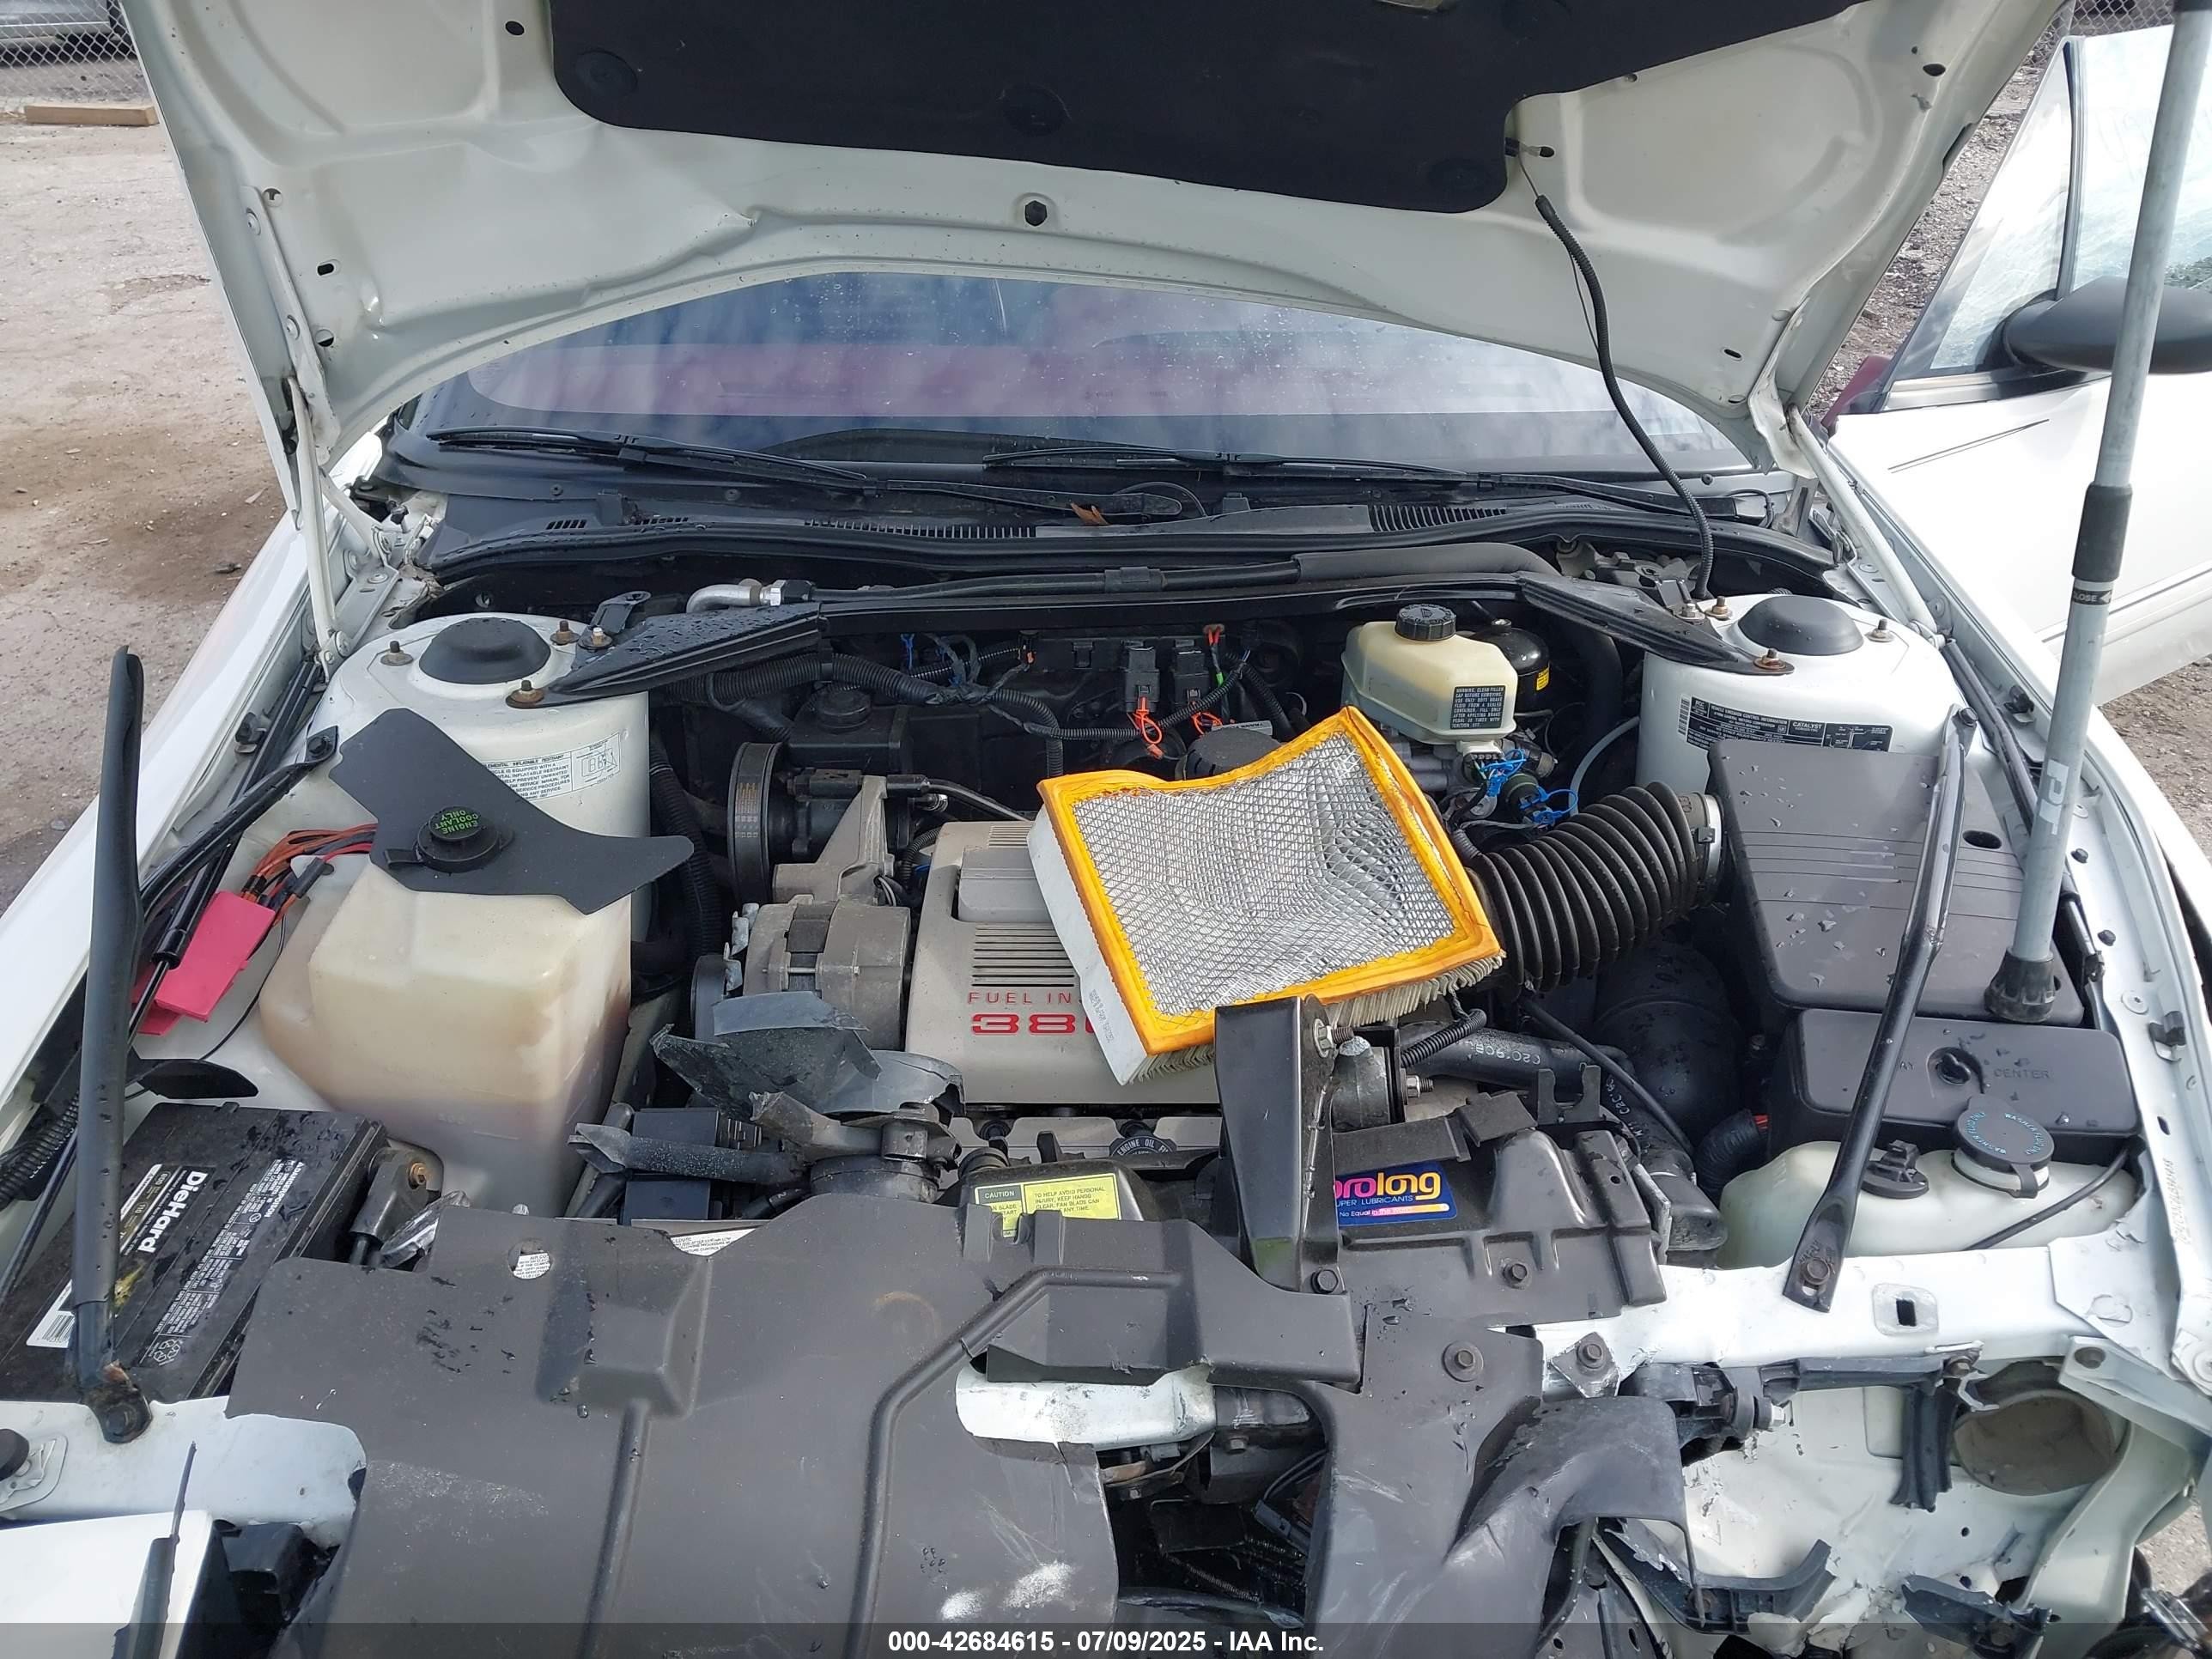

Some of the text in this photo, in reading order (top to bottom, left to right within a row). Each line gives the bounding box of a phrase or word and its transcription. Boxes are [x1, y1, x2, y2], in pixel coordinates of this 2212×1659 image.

[434, 813, 479, 830] COOLANT
[441, 810, 465, 820] ONLY
[441, 820, 478, 834] ENGINE
[968, 993, 1071, 1004] FUEL IN
[972, 1013, 1094, 1034] 38
[1994, 1068, 2050, 1079] CENTER
[1117, 1139, 1140, 1156] ENGINE
[1145, 1139, 1155, 1148] OIL
[1158, 1145, 1169, 1153] FI
[264, 1167, 301, 1217] DANGER/POISON
[984, 1190, 1015, 1199] CAUTION
[1361, 1194, 1413, 1205] LUBRICANTS
[138, 1170, 208, 1254] DieHard
